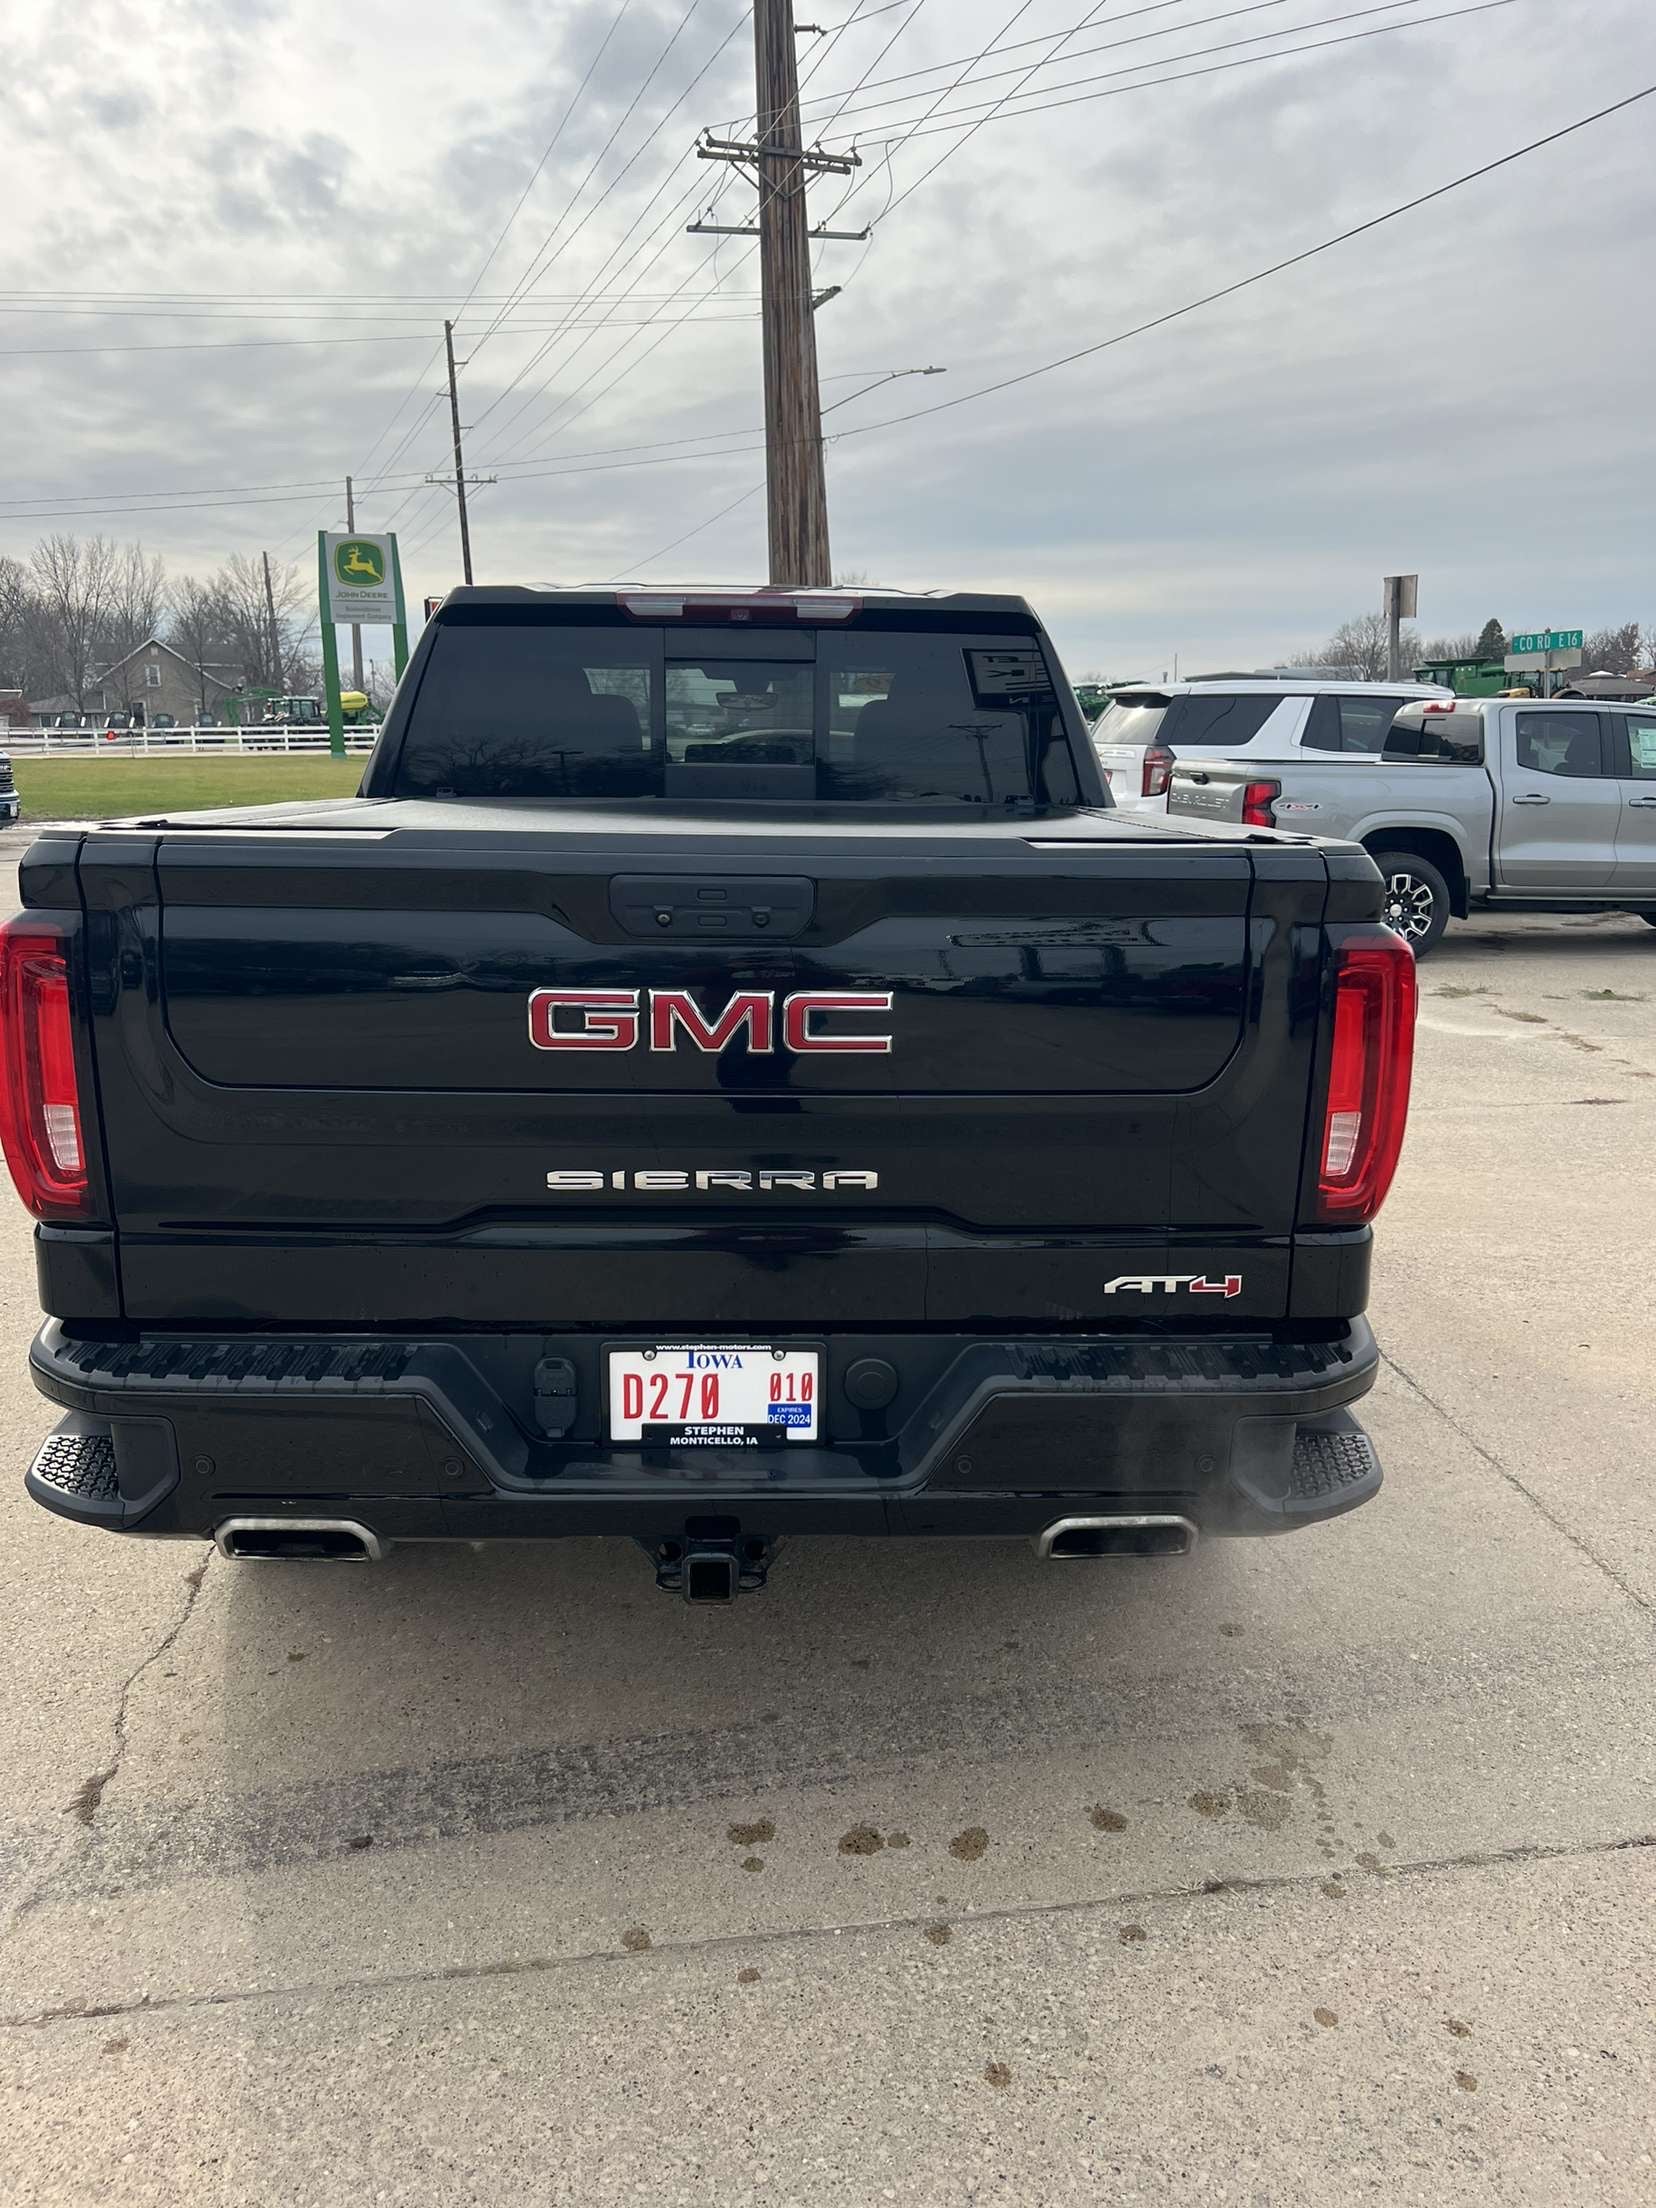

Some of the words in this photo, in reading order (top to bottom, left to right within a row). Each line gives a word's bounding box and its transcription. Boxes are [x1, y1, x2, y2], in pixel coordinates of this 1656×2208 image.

[1520, 637, 1533, 651] CO
[1537, 635, 1551, 649] RD
[528, 986, 894, 1053] GMC
[546, 1170, 879, 1191] SIERRA
[1104, 1275, 1242, 1298] AT4
[623, 1373, 720, 1419] D270
[770, 1372, 813, 1401] 010
[768, 1414, 786, 1424] DEC
[788, 1414, 811, 1424] 2024
[684, 1426, 744, 1435] STEPHEN
[670, 1436, 745, 1446] MONTICELLO,
[746, 1436, 758, 1445] IA
